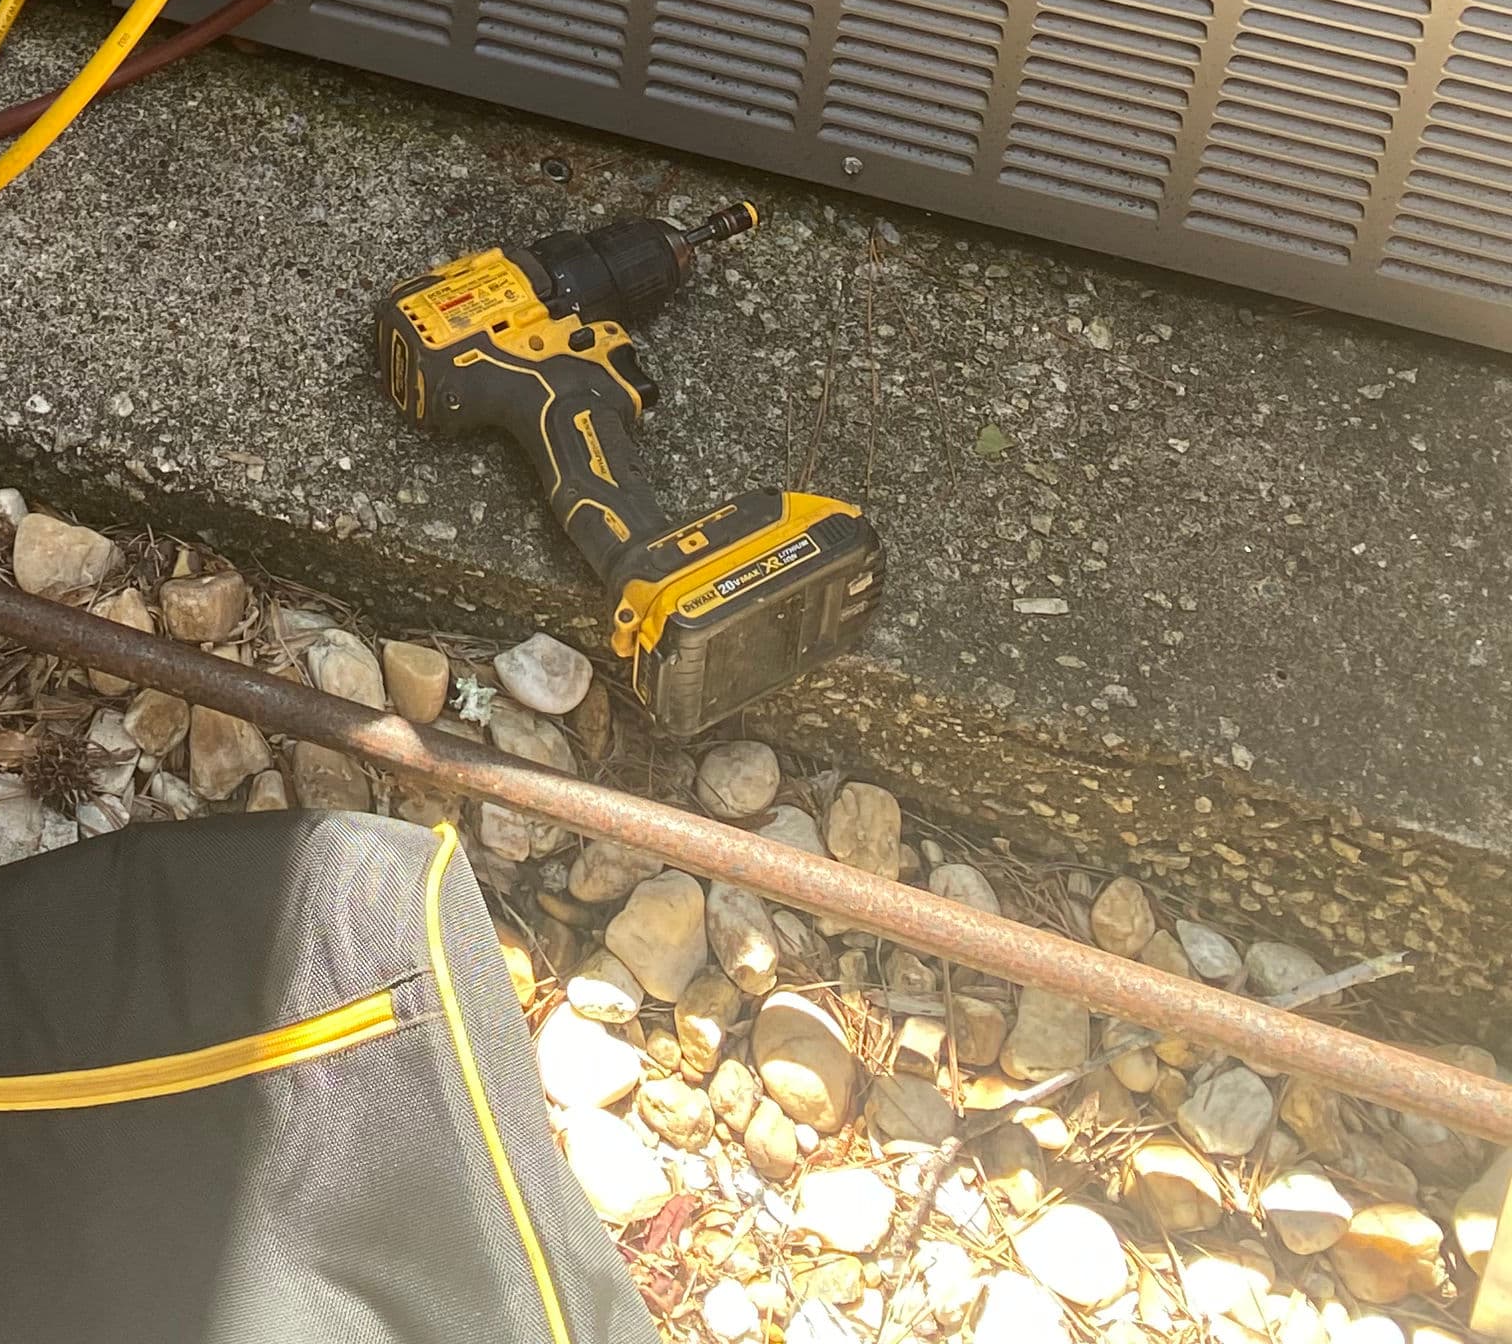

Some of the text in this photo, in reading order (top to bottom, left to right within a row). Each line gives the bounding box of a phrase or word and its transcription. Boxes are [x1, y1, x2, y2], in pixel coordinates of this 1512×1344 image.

[778, 539, 809, 559] LITHIUM
[782, 553, 799, 564] ION
[740, 569, 761, 584] MAX
[761, 555, 785, 574] XR
